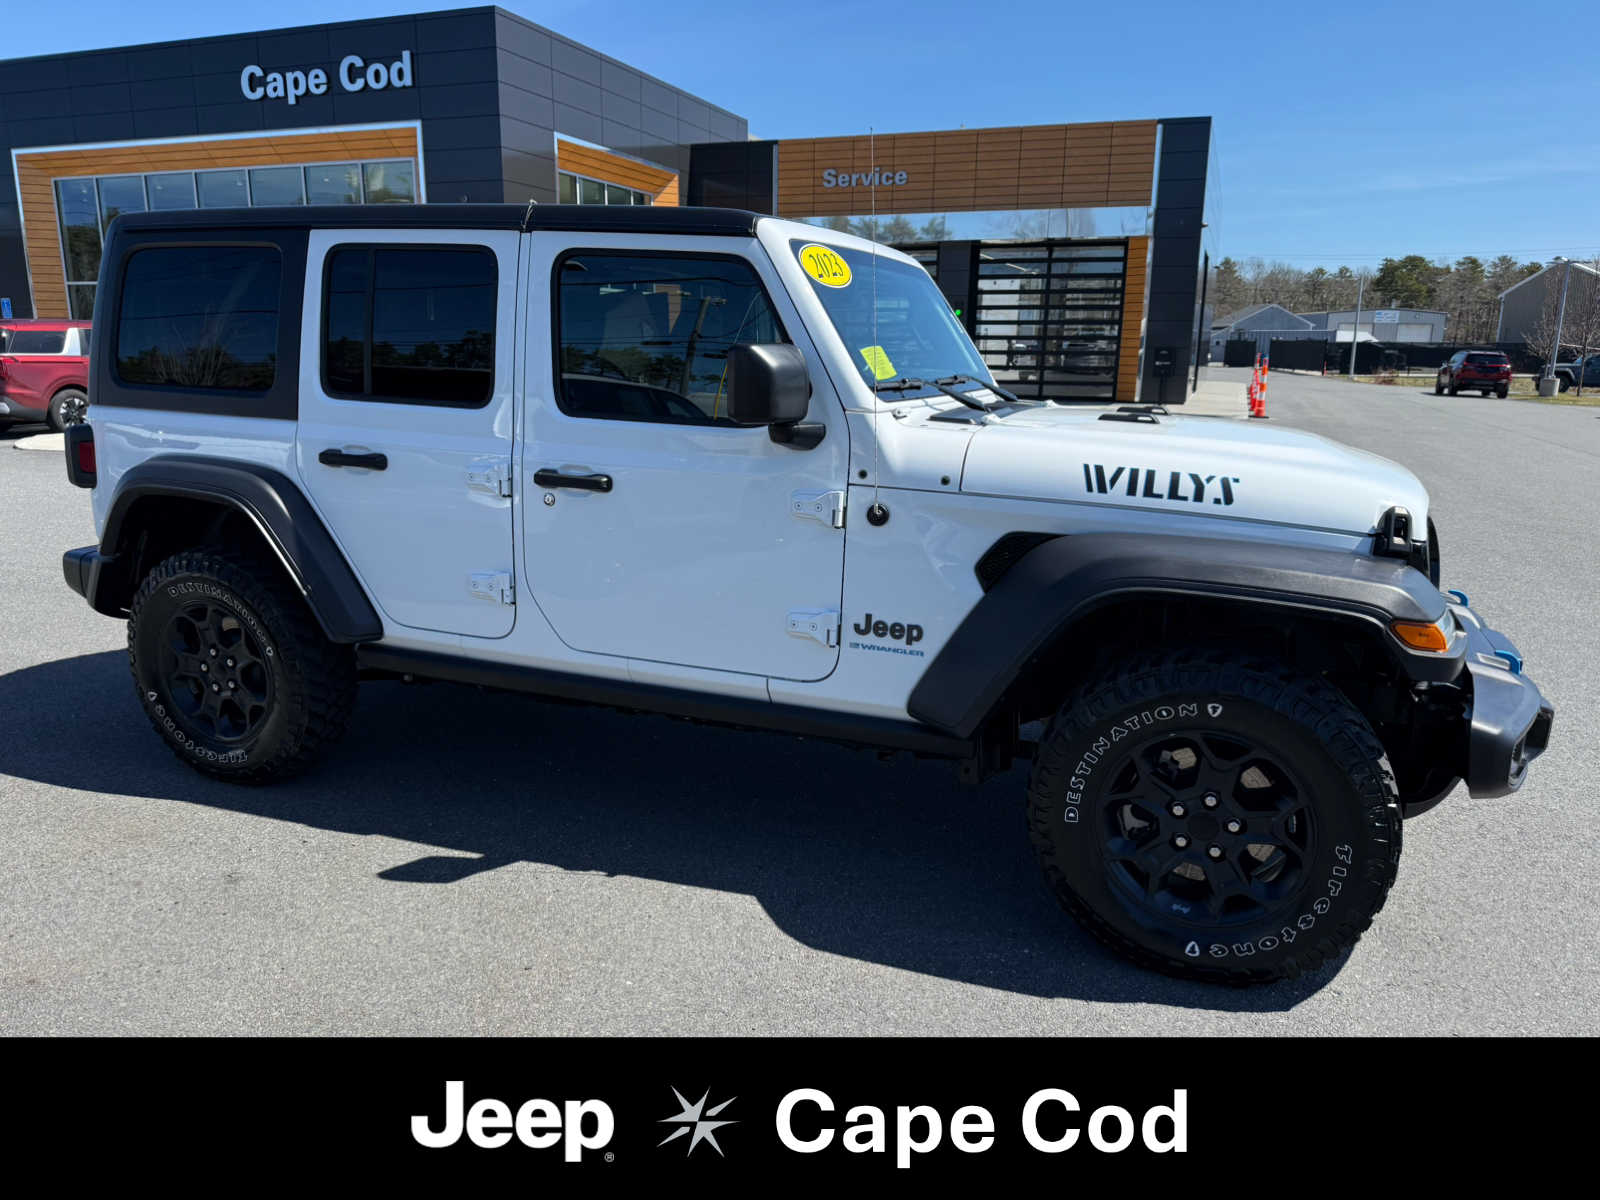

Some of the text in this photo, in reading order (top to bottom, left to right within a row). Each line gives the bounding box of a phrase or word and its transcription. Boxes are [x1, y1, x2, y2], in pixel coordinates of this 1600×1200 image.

[240, 50, 413, 105] Cape Cod
[823, 167, 908, 188] Service
[807, 252, 844, 279] 2023
[1083, 463, 1240, 506] WILLYS
[853, 612, 924, 646] Jeep
[1064, 703, 1198, 823] DESTINATION
[1209, 844, 1353, 958] Firestone
